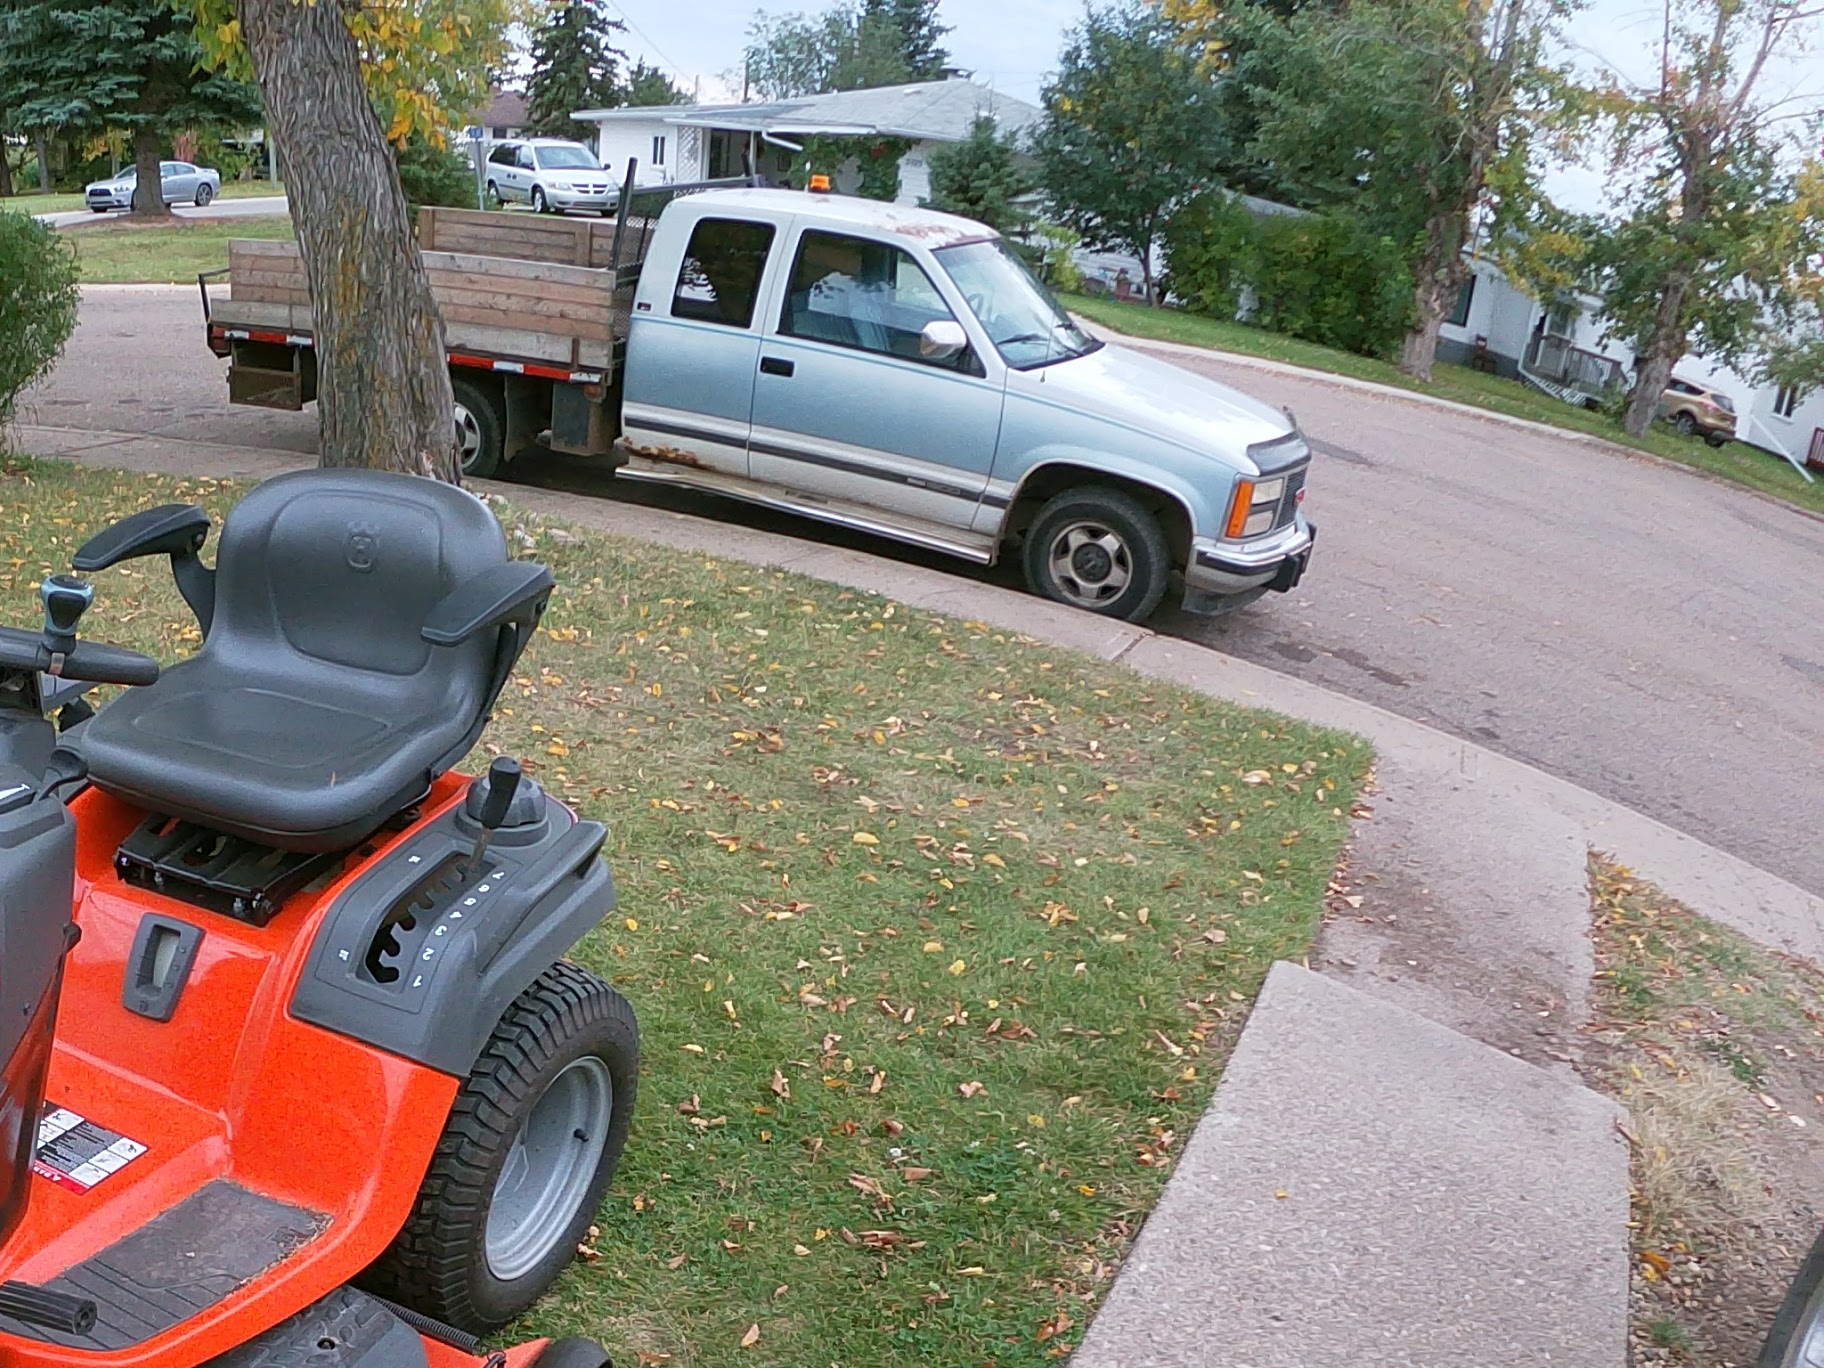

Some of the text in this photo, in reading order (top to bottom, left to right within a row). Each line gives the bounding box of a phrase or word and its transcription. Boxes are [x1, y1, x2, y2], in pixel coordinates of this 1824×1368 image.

[434, 925, 448, 936] 3
[422, 947, 435, 961] 2
[412, 975, 423, 988] 1
